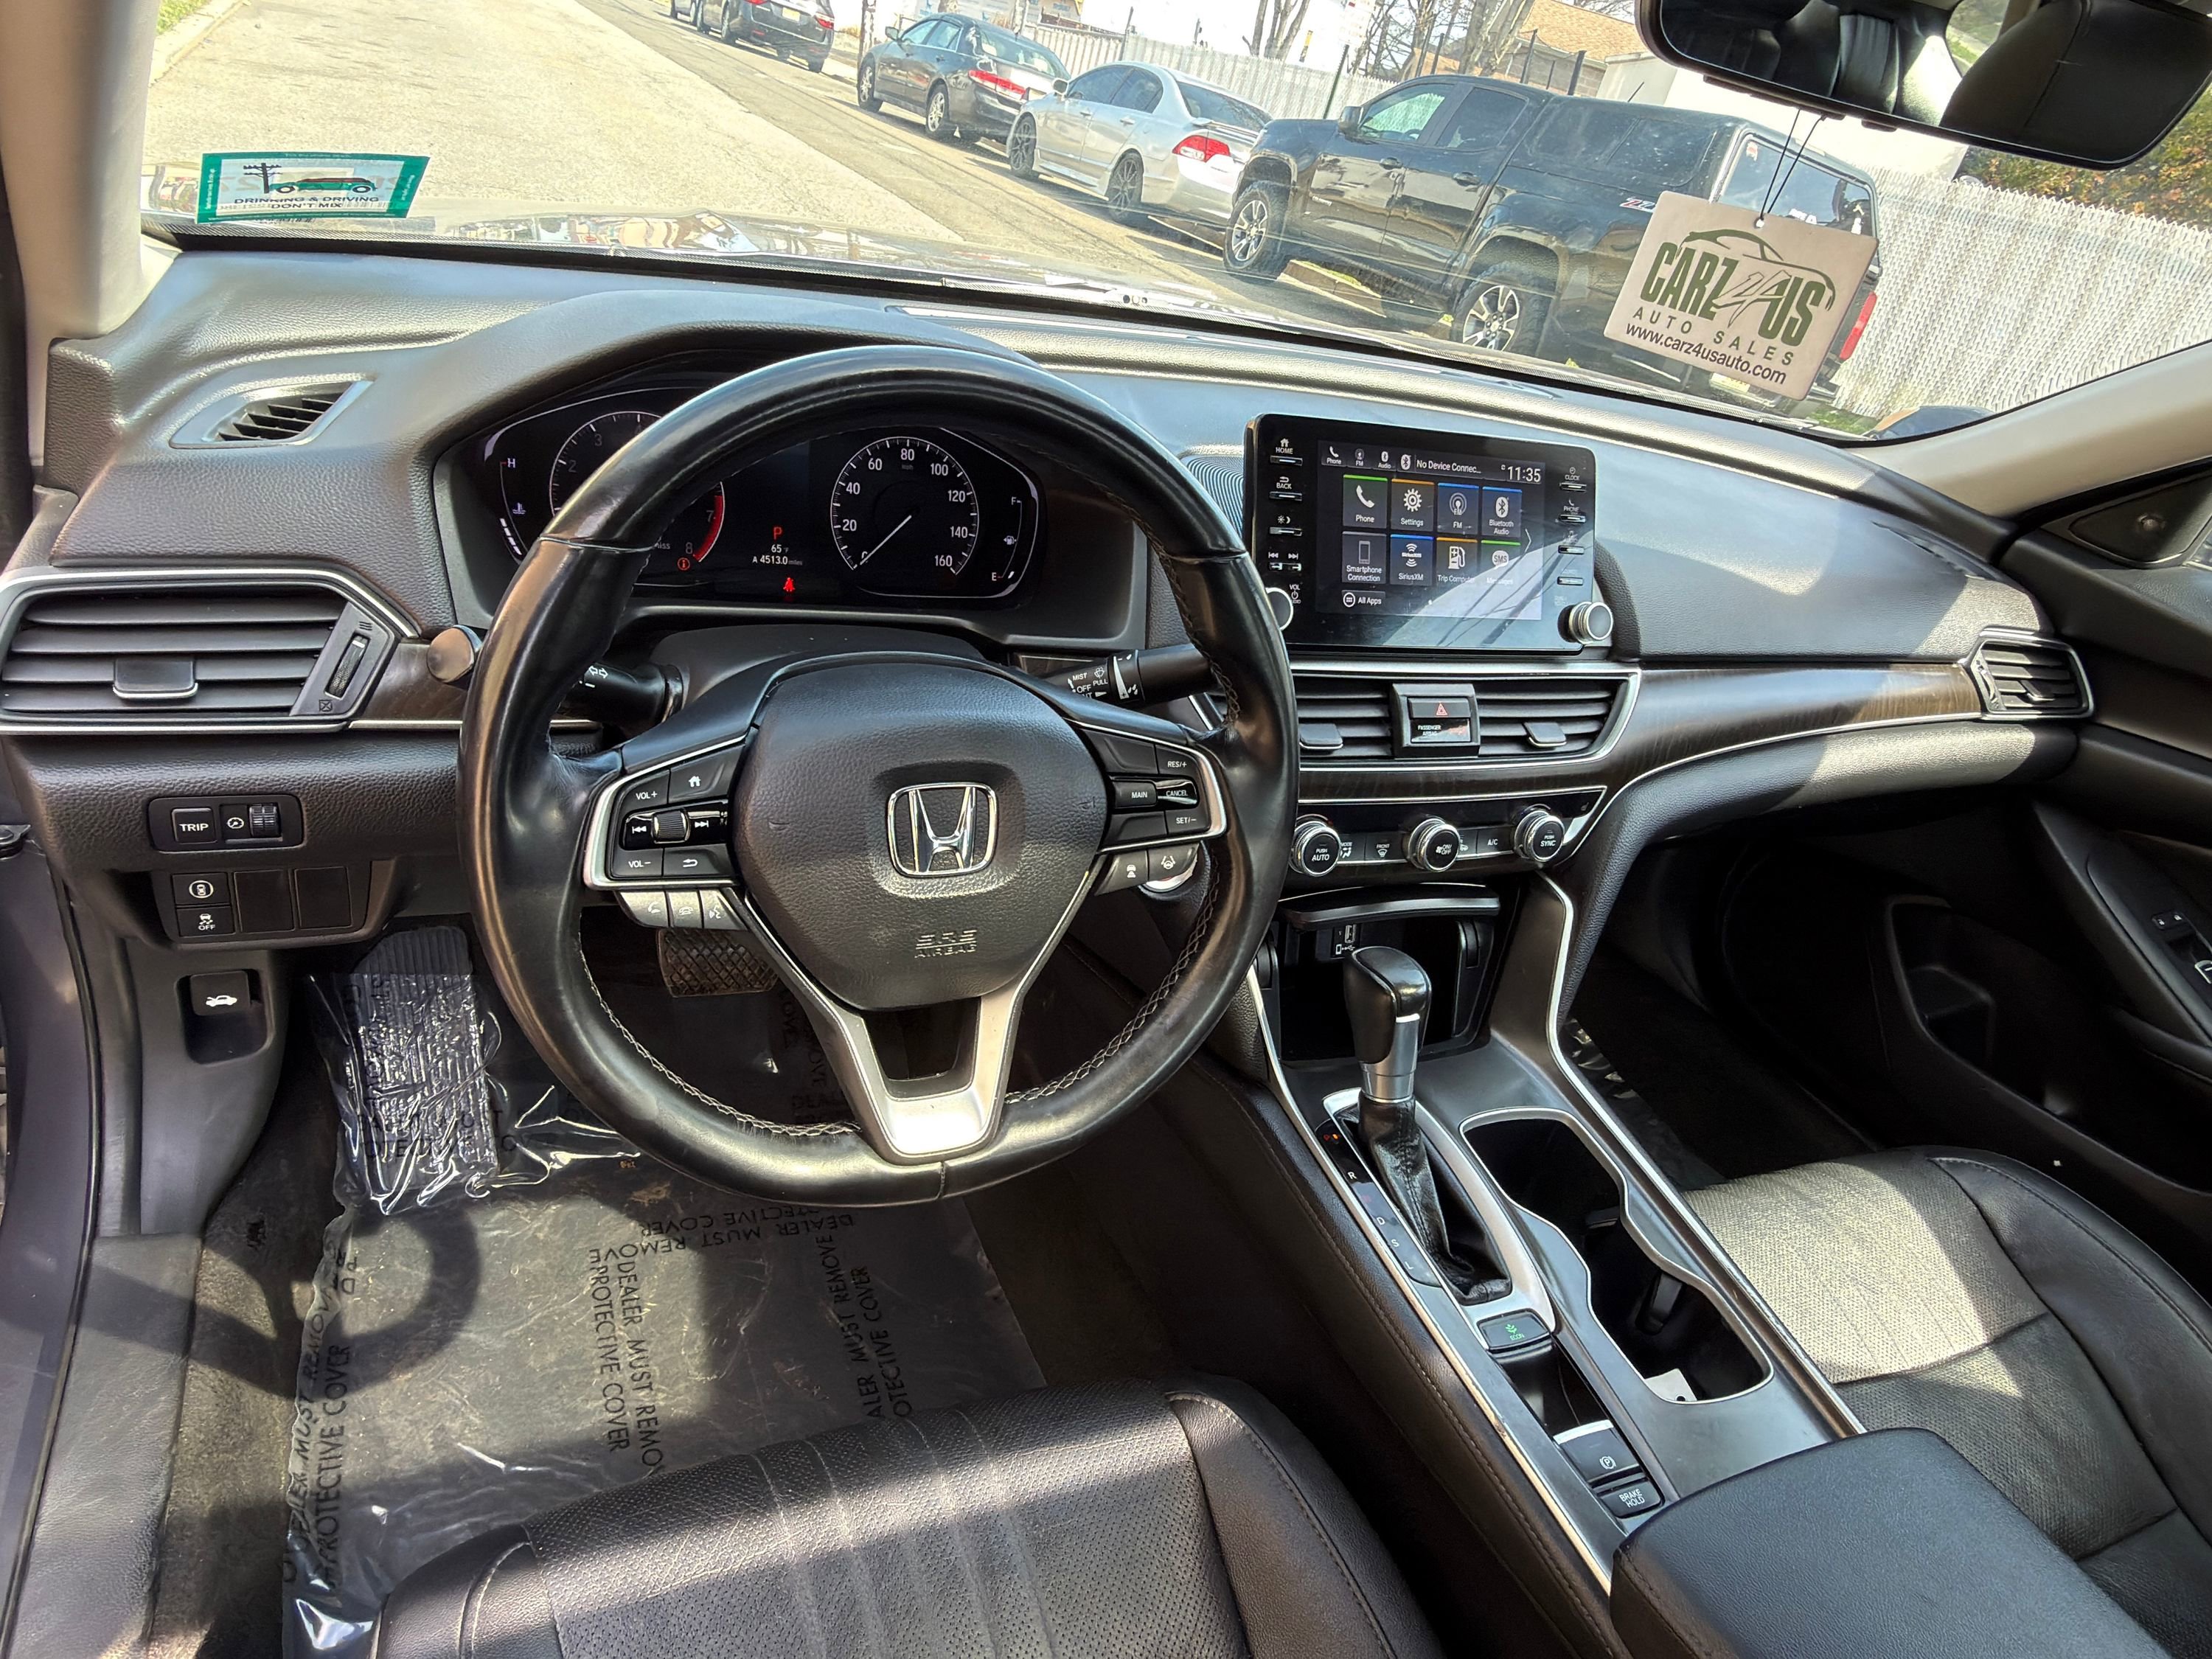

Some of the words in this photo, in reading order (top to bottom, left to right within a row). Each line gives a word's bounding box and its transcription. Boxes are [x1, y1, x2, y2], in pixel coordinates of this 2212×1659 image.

[234, 196, 305, 204] DRINKING
[1632, 306, 1693, 335] AUTO
[1713, 330, 1795, 366] SALES
[1626, 321, 1787, 386] www.carz4usauto.com
[900, 448, 915, 461] 80
[507, 458, 515, 468] H
[568, 461, 577, 473] 2
[868, 458, 883, 470] 60
[1416, 459, 1427, 469] No
[1427, 461, 1450, 471] Device
[930, 463, 949, 476] 100
[1507, 465, 1542, 483] 11:35
[846, 482, 860, 495] 40
[947, 490, 966, 503] 120
[1011, 497, 1016, 505] F
[1355, 515, 1375, 523] Phone
[1400, 518, 1424, 527] Settings
[1489, 519, 1514, 528] Bluetooth
[842, 519, 857, 532] 20
[773, 526, 783, 540] P
[950, 526, 968, 538] 140
[685, 542, 693, 554] 8
[771, 544, 782, 553] 65
[759, 554, 788, 565] 4513.0
[934, 555, 953, 567] 160
[1493, 554, 1508, 563] SMS
[991, 572, 997, 581] E
[1346, 566, 1382, 575] Smartphone
[1347, 574, 1380, 582] Connection
[1398, 573, 1424, 581] SiriusXM
[1438, 574, 1448, 582] Trip
[1366, 597, 1382, 605] Apps
[1072, 672, 1088, 681] MIST
[1093, 678, 1108, 686] PULL
[1077, 684, 1091, 693] OFF
[179, 822, 209, 832] TRIP
[1347, 1171, 1357, 1180] R
[641, 1215, 714, 1237] COVER
[776, 1214, 855, 1236] DEALER
[1376, 1217, 1385, 1225] D
[700, 1227, 761, 1248] MUST
[1391, 1239, 1399, 1248] S
[589, 1237, 686, 1264] REMOVE
[815, 1234, 851, 1304] REMOVE
[1404, 1261, 1414, 1270] L
[618, 1262, 643, 1327] DEALER
[850, 1265, 882, 1322] COVER
[591, 1265, 621, 1375] PROTECTIVE
[838, 1314, 869, 1363] MUST
[1509, 1332, 1526, 1340] ECON
[626, 1340, 654, 1391] MUST
[870, 1329, 912, 1418] OTECTIVE
[321, 1345, 350, 1416] COVER
[857, 1374, 885, 1419] ALER
[602, 1382, 630, 1452] COVER
[1618, 1489, 1643, 1502] BRAKE
[1625, 1496, 1646, 1509] HOLD
